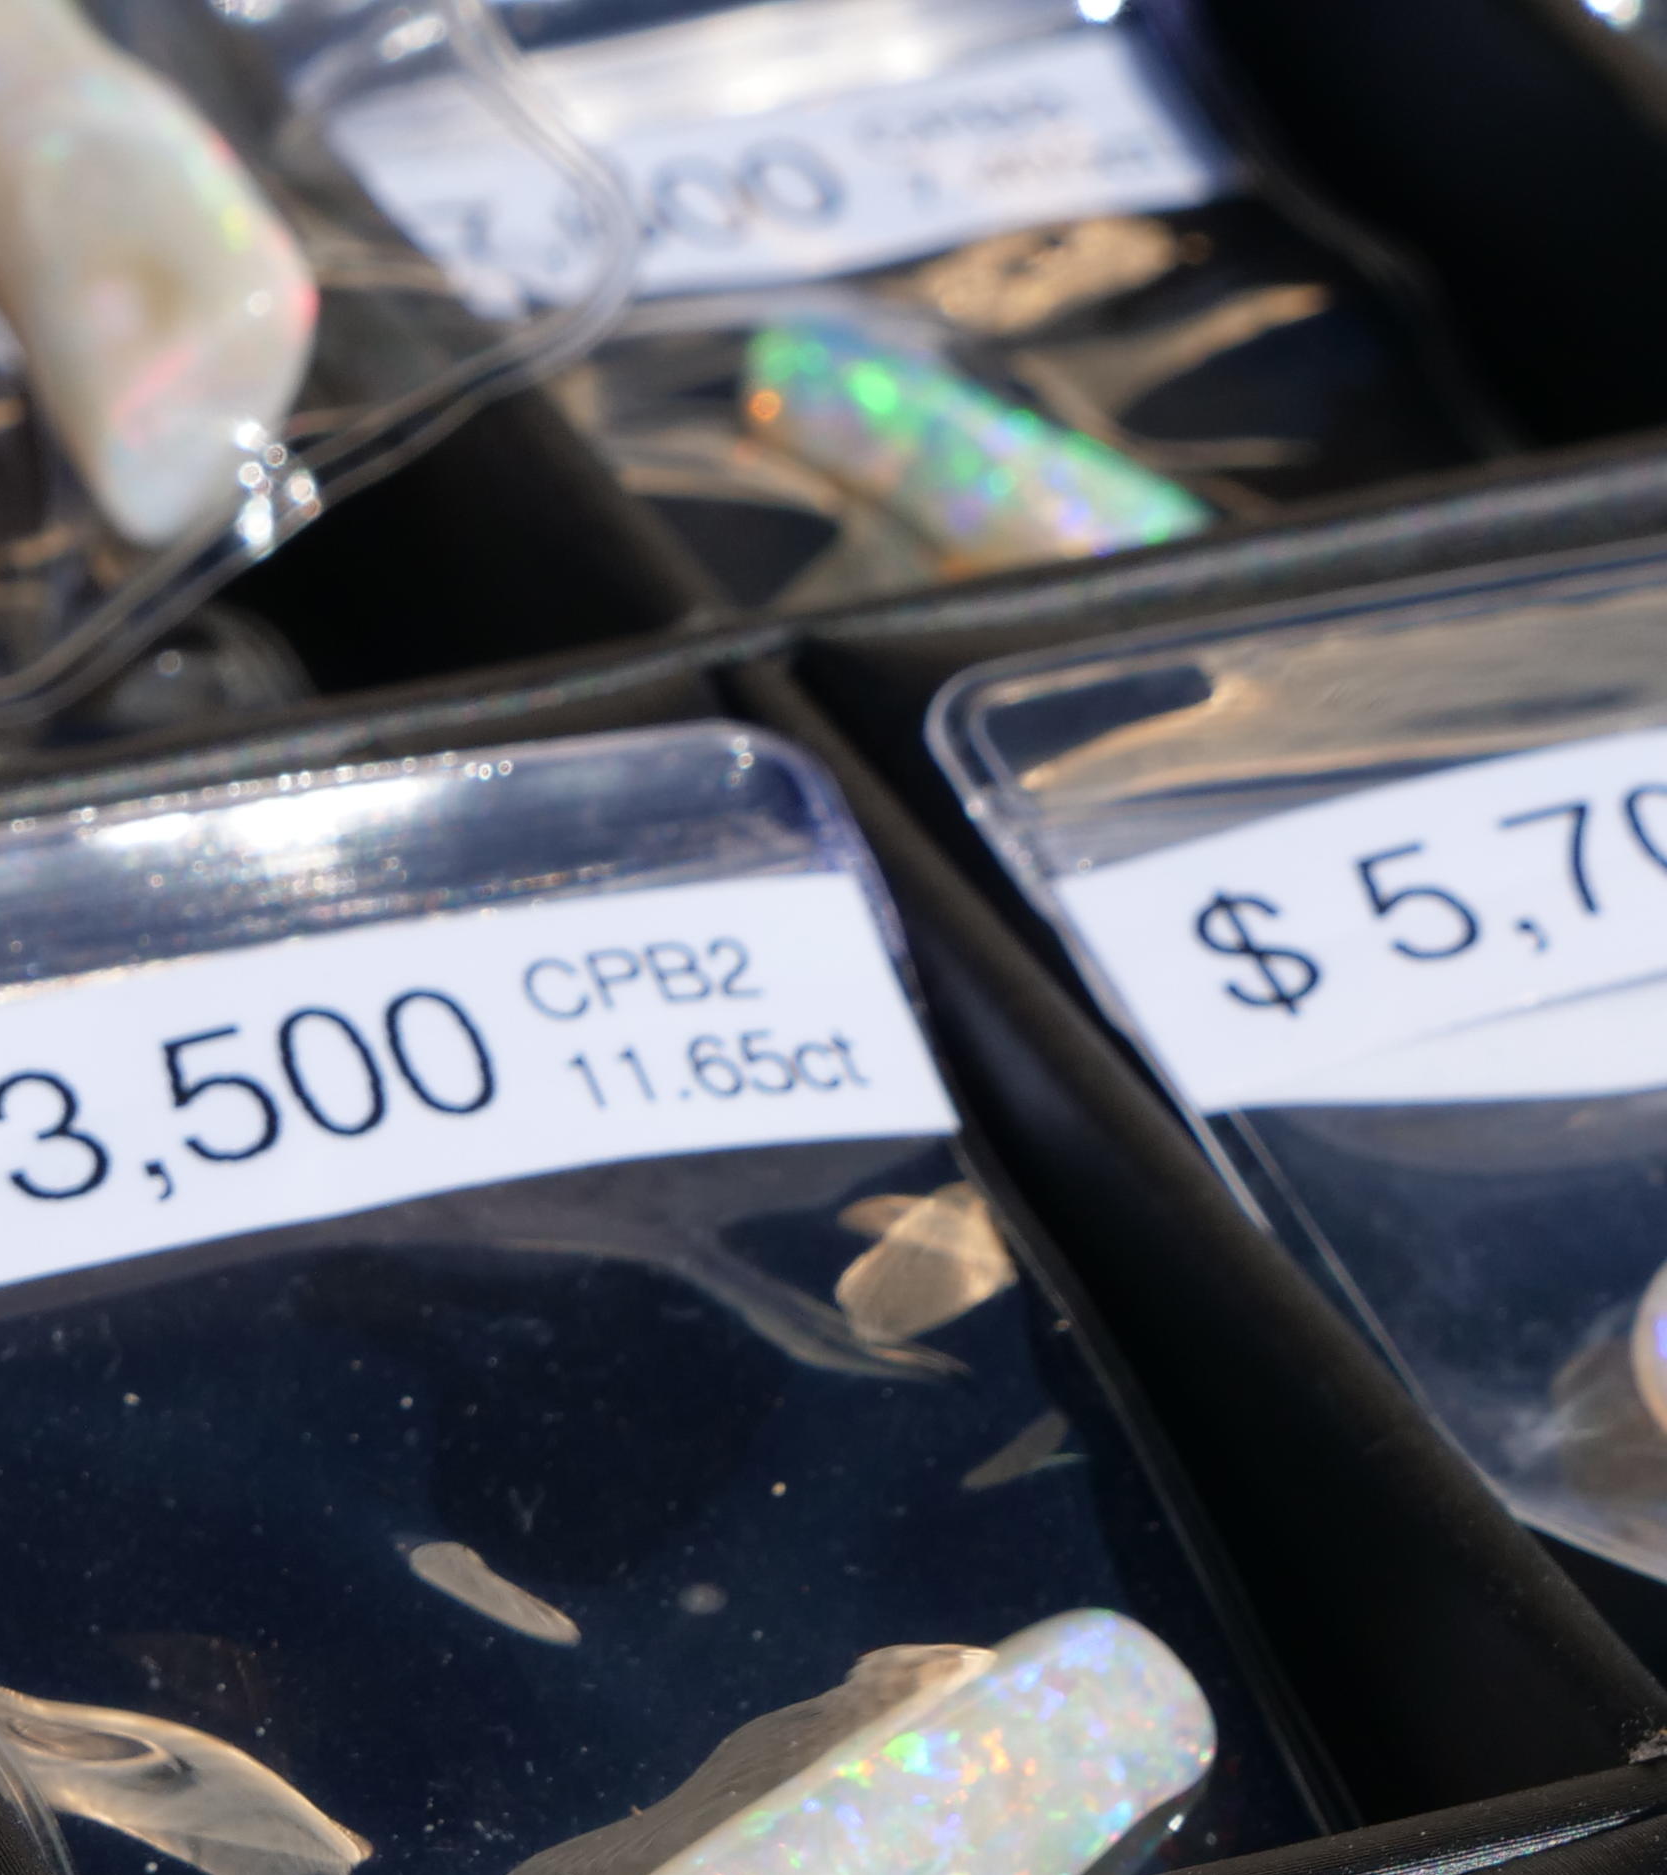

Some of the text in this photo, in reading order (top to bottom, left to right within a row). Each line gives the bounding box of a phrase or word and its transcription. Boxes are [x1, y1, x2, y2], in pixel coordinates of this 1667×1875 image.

[520, 936, 767, 1022] CPB2
[1192, 888, 1323, 1017] $
[567, 1026, 871, 1112] 11.65ct
